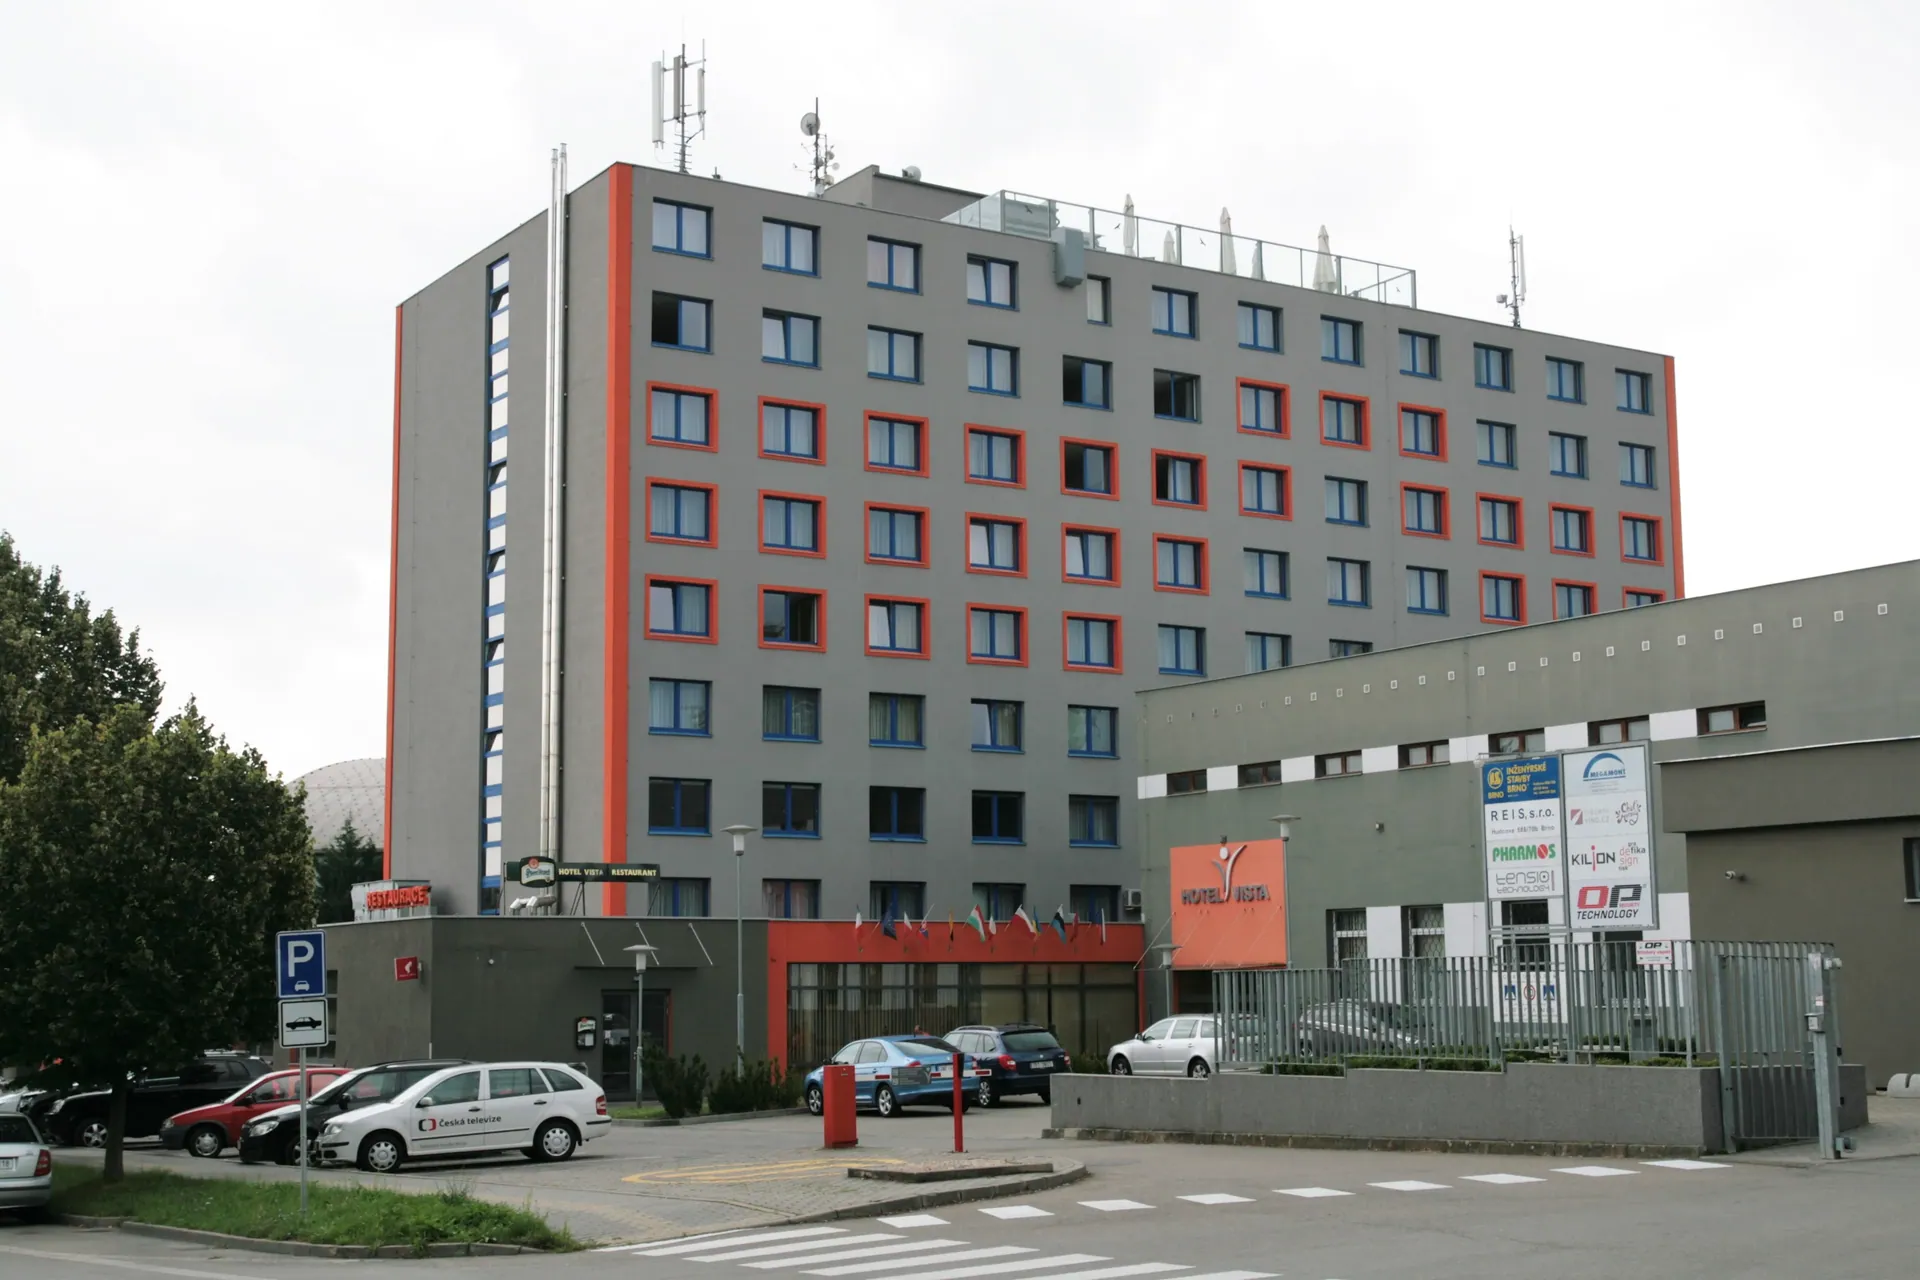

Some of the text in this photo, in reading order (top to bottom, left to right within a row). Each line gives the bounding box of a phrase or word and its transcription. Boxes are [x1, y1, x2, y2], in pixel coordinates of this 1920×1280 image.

[1507, 775, 1531, 784] STAVBY
[1507, 784, 1527, 793] BRNO
[1488, 791, 1504, 799] BRNO
[1493, 844, 1556, 862] PHARMOS
[558, 868, 582, 876] HOTEL
[584, 868, 604, 876] VISTA
[611, 869, 657, 877] RESTAURANT
[367, 886, 428, 908] RESTAURACE
[1182, 884, 1271, 905] HOTEL VISTA
[1577, 884, 1642, 909] OP
[1577, 909, 1639, 920] TECHNOLOGY
[288, 940, 314, 977] P
[439, 1115, 502, 1127] Česká televize
